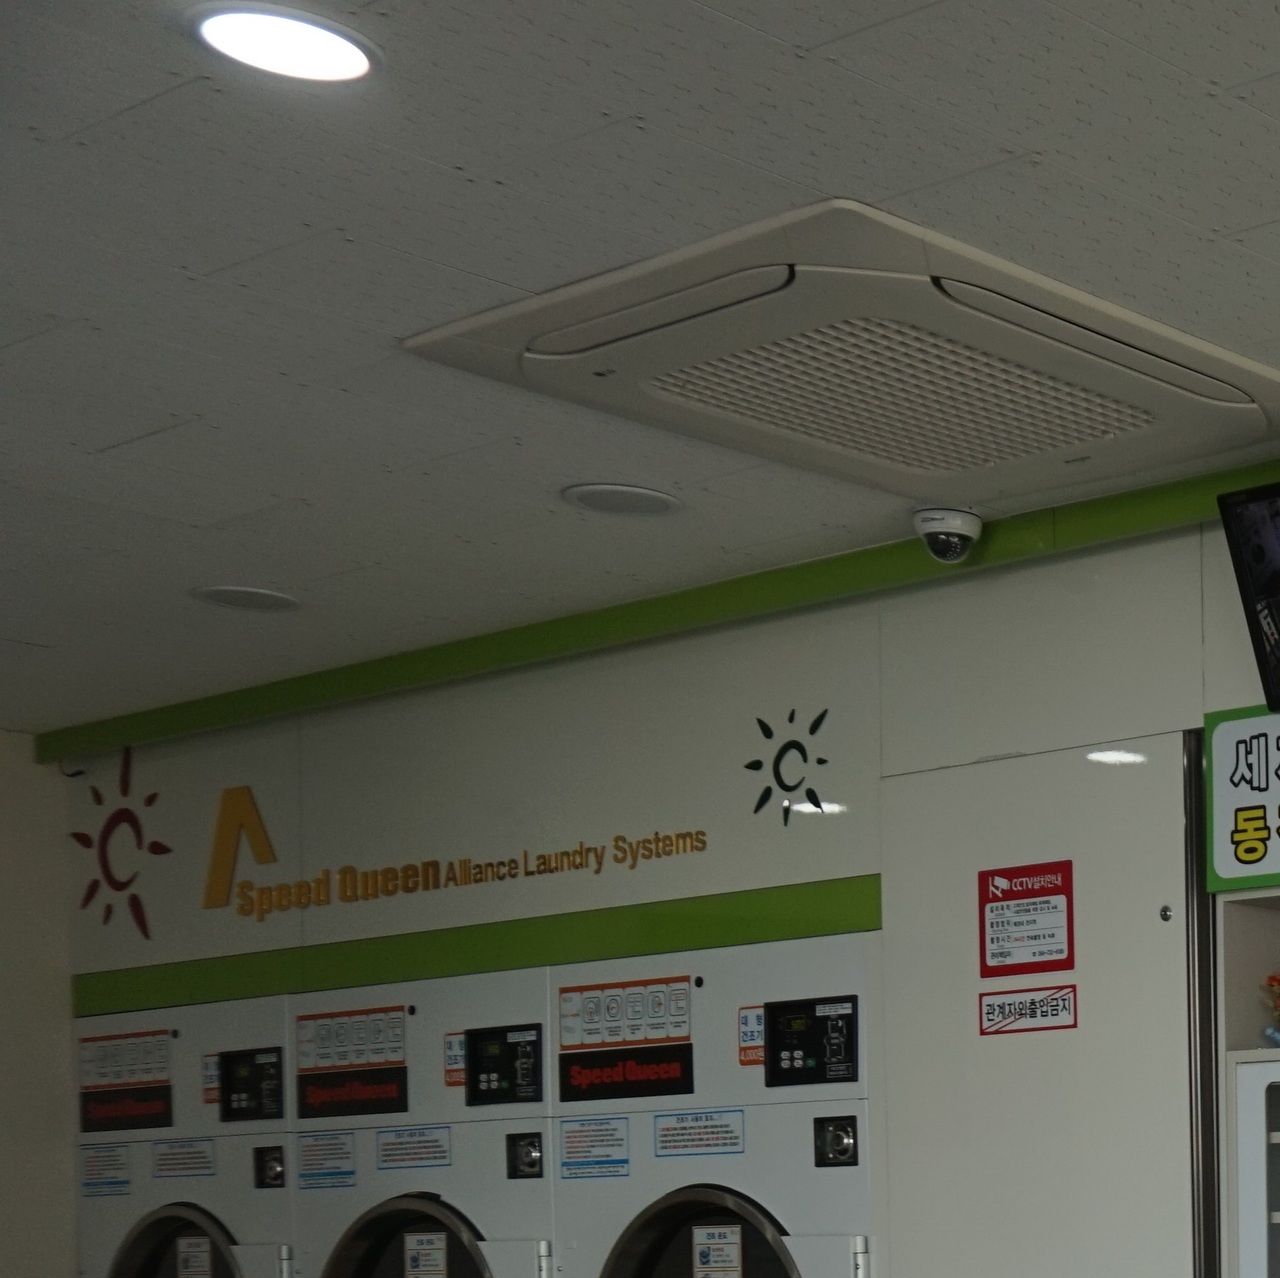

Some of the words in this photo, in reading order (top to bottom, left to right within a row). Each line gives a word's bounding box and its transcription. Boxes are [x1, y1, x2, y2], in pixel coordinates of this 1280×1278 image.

[236, 869, 330, 922] Speed
[338, 858, 442, 902] Queen
[444, 859, 519, 888] Alliance
[523, 841, 606, 878] Laundry
[613, 829, 707, 869] Systems
[986, 996, 1071, 1022] 관계자외출입금지
